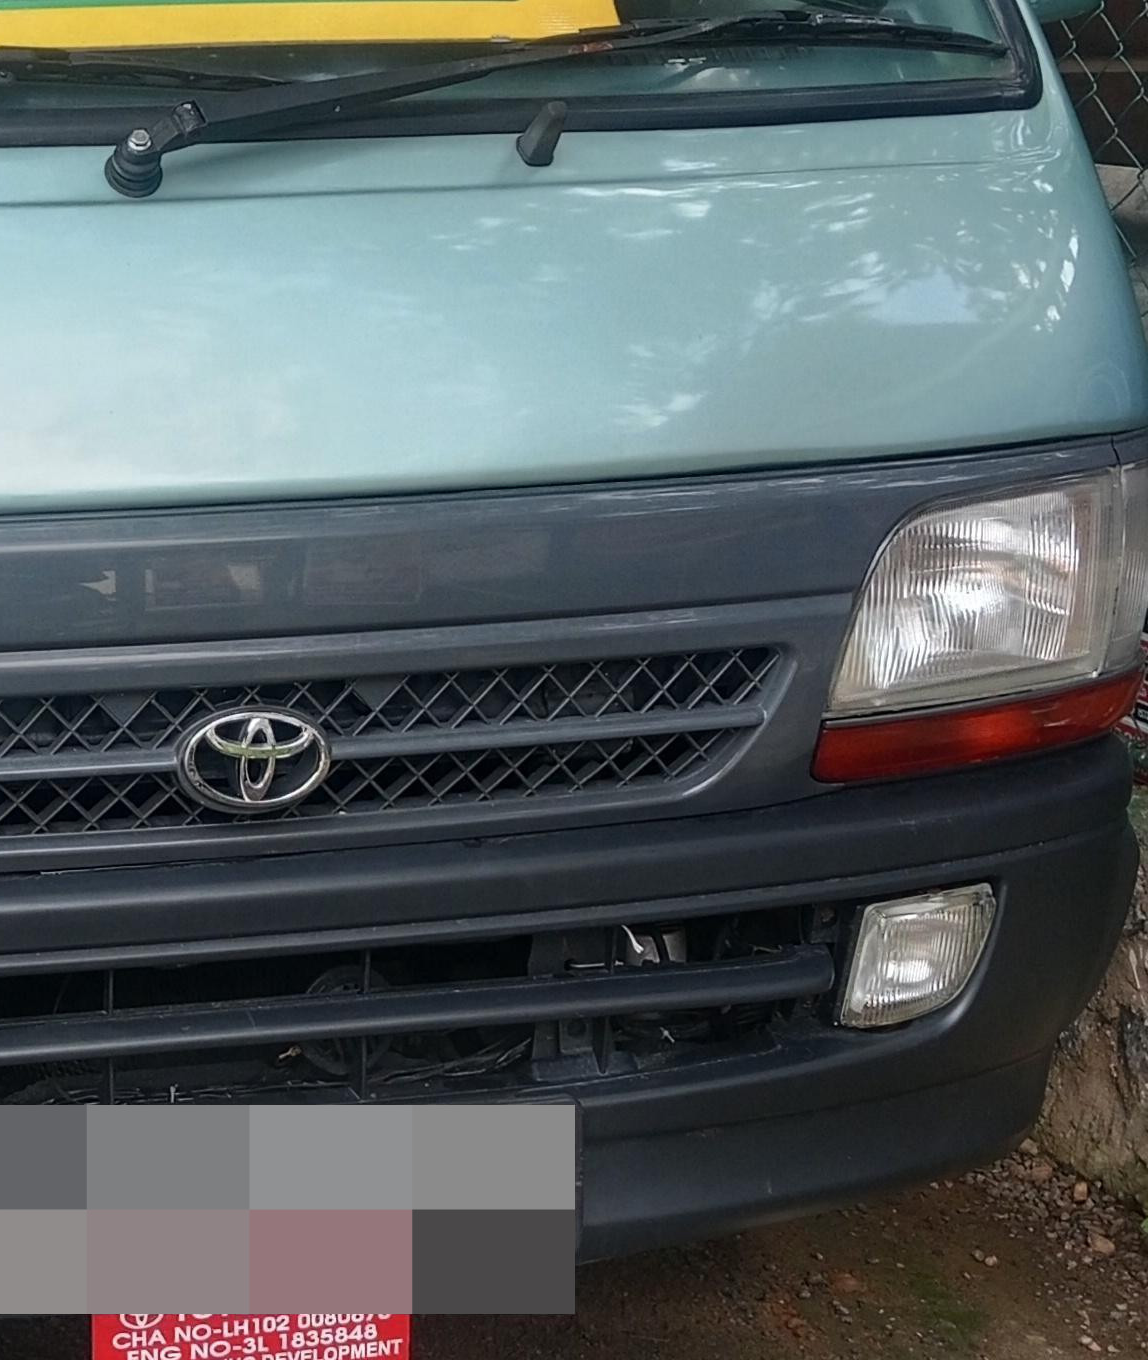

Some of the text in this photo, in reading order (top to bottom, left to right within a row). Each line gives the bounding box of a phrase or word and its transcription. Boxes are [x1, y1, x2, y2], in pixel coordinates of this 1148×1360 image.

[112, 1329, 166, 1349] CHA
[174, 1315, 290, 1343] NO-LH102
[191, 1337, 269, 1360] NO-3L
[279, 1324, 377, 1349] 1835848
